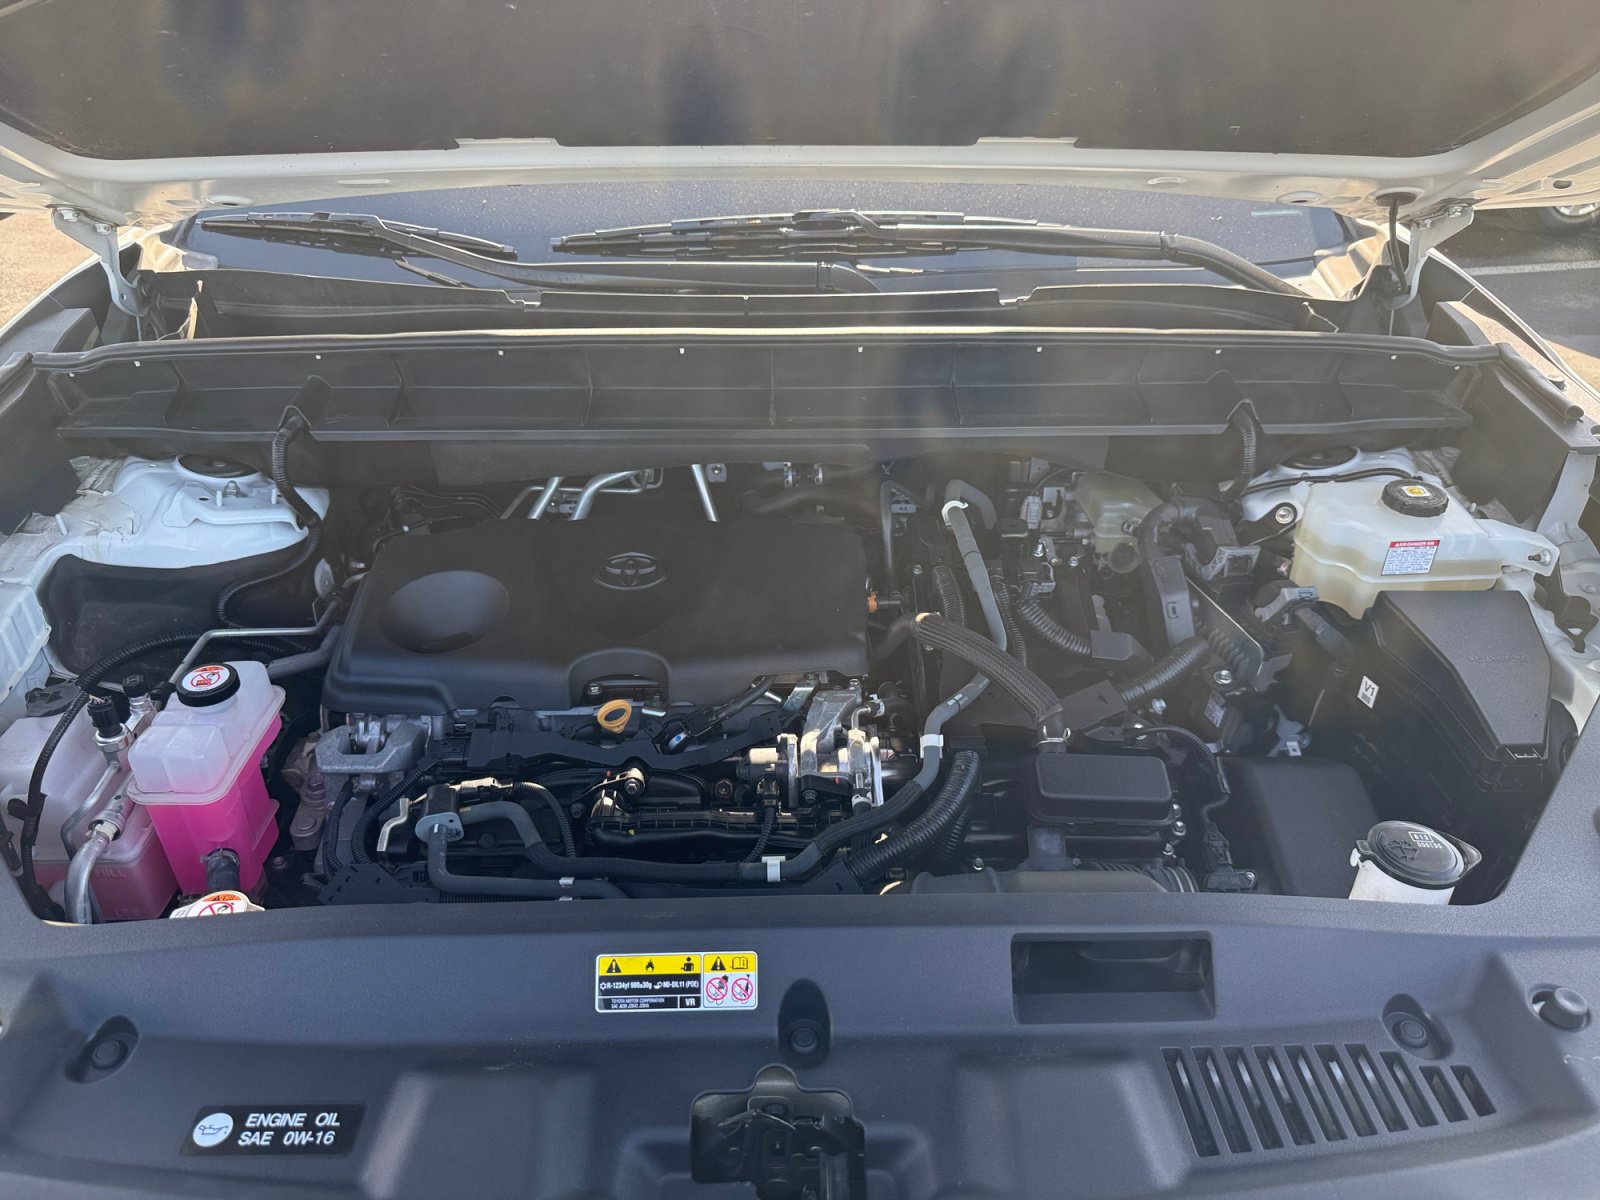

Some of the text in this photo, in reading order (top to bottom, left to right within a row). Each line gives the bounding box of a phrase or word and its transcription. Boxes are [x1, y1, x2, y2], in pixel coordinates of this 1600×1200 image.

[1364, 680, 1376, 697] V1
[685, 998, 696, 1007] VR
[245, 1112, 341, 1127] ENGINE OIL
[237, 1130, 336, 1146] SAE 0W-16
